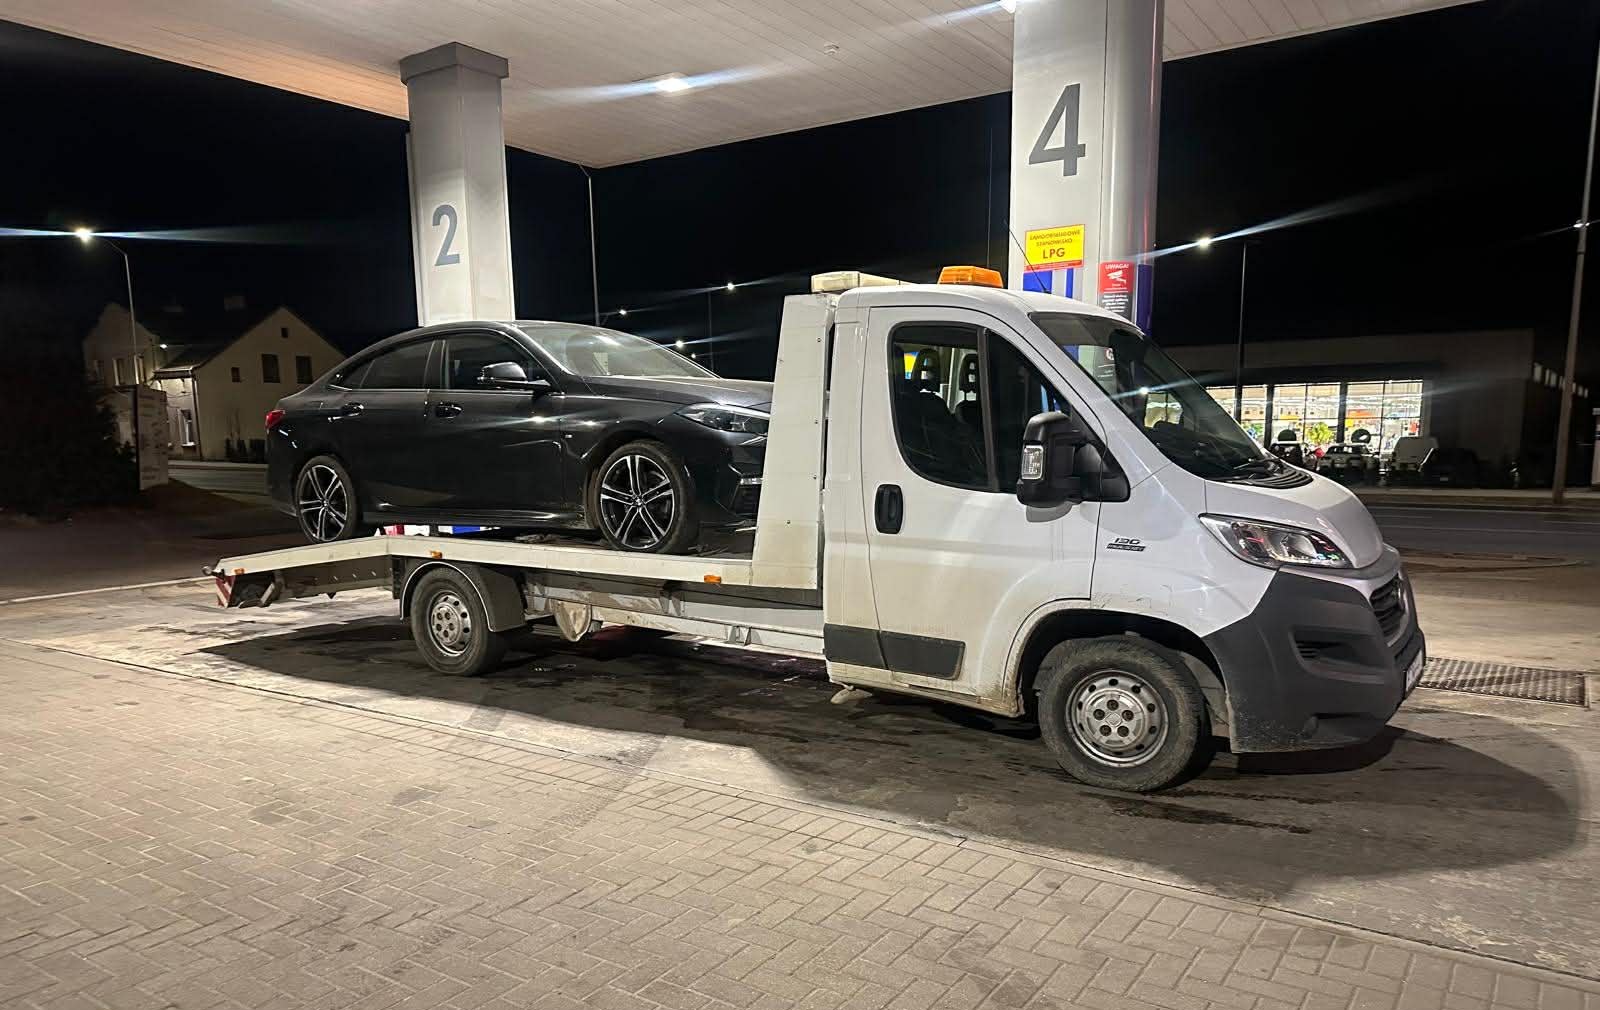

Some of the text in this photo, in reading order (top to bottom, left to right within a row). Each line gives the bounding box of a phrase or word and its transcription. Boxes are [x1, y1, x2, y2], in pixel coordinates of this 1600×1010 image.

[1028, 83, 1086, 176] 4
[432, 204, 461, 266] 2
[1042, 247, 1066, 259] LPG
